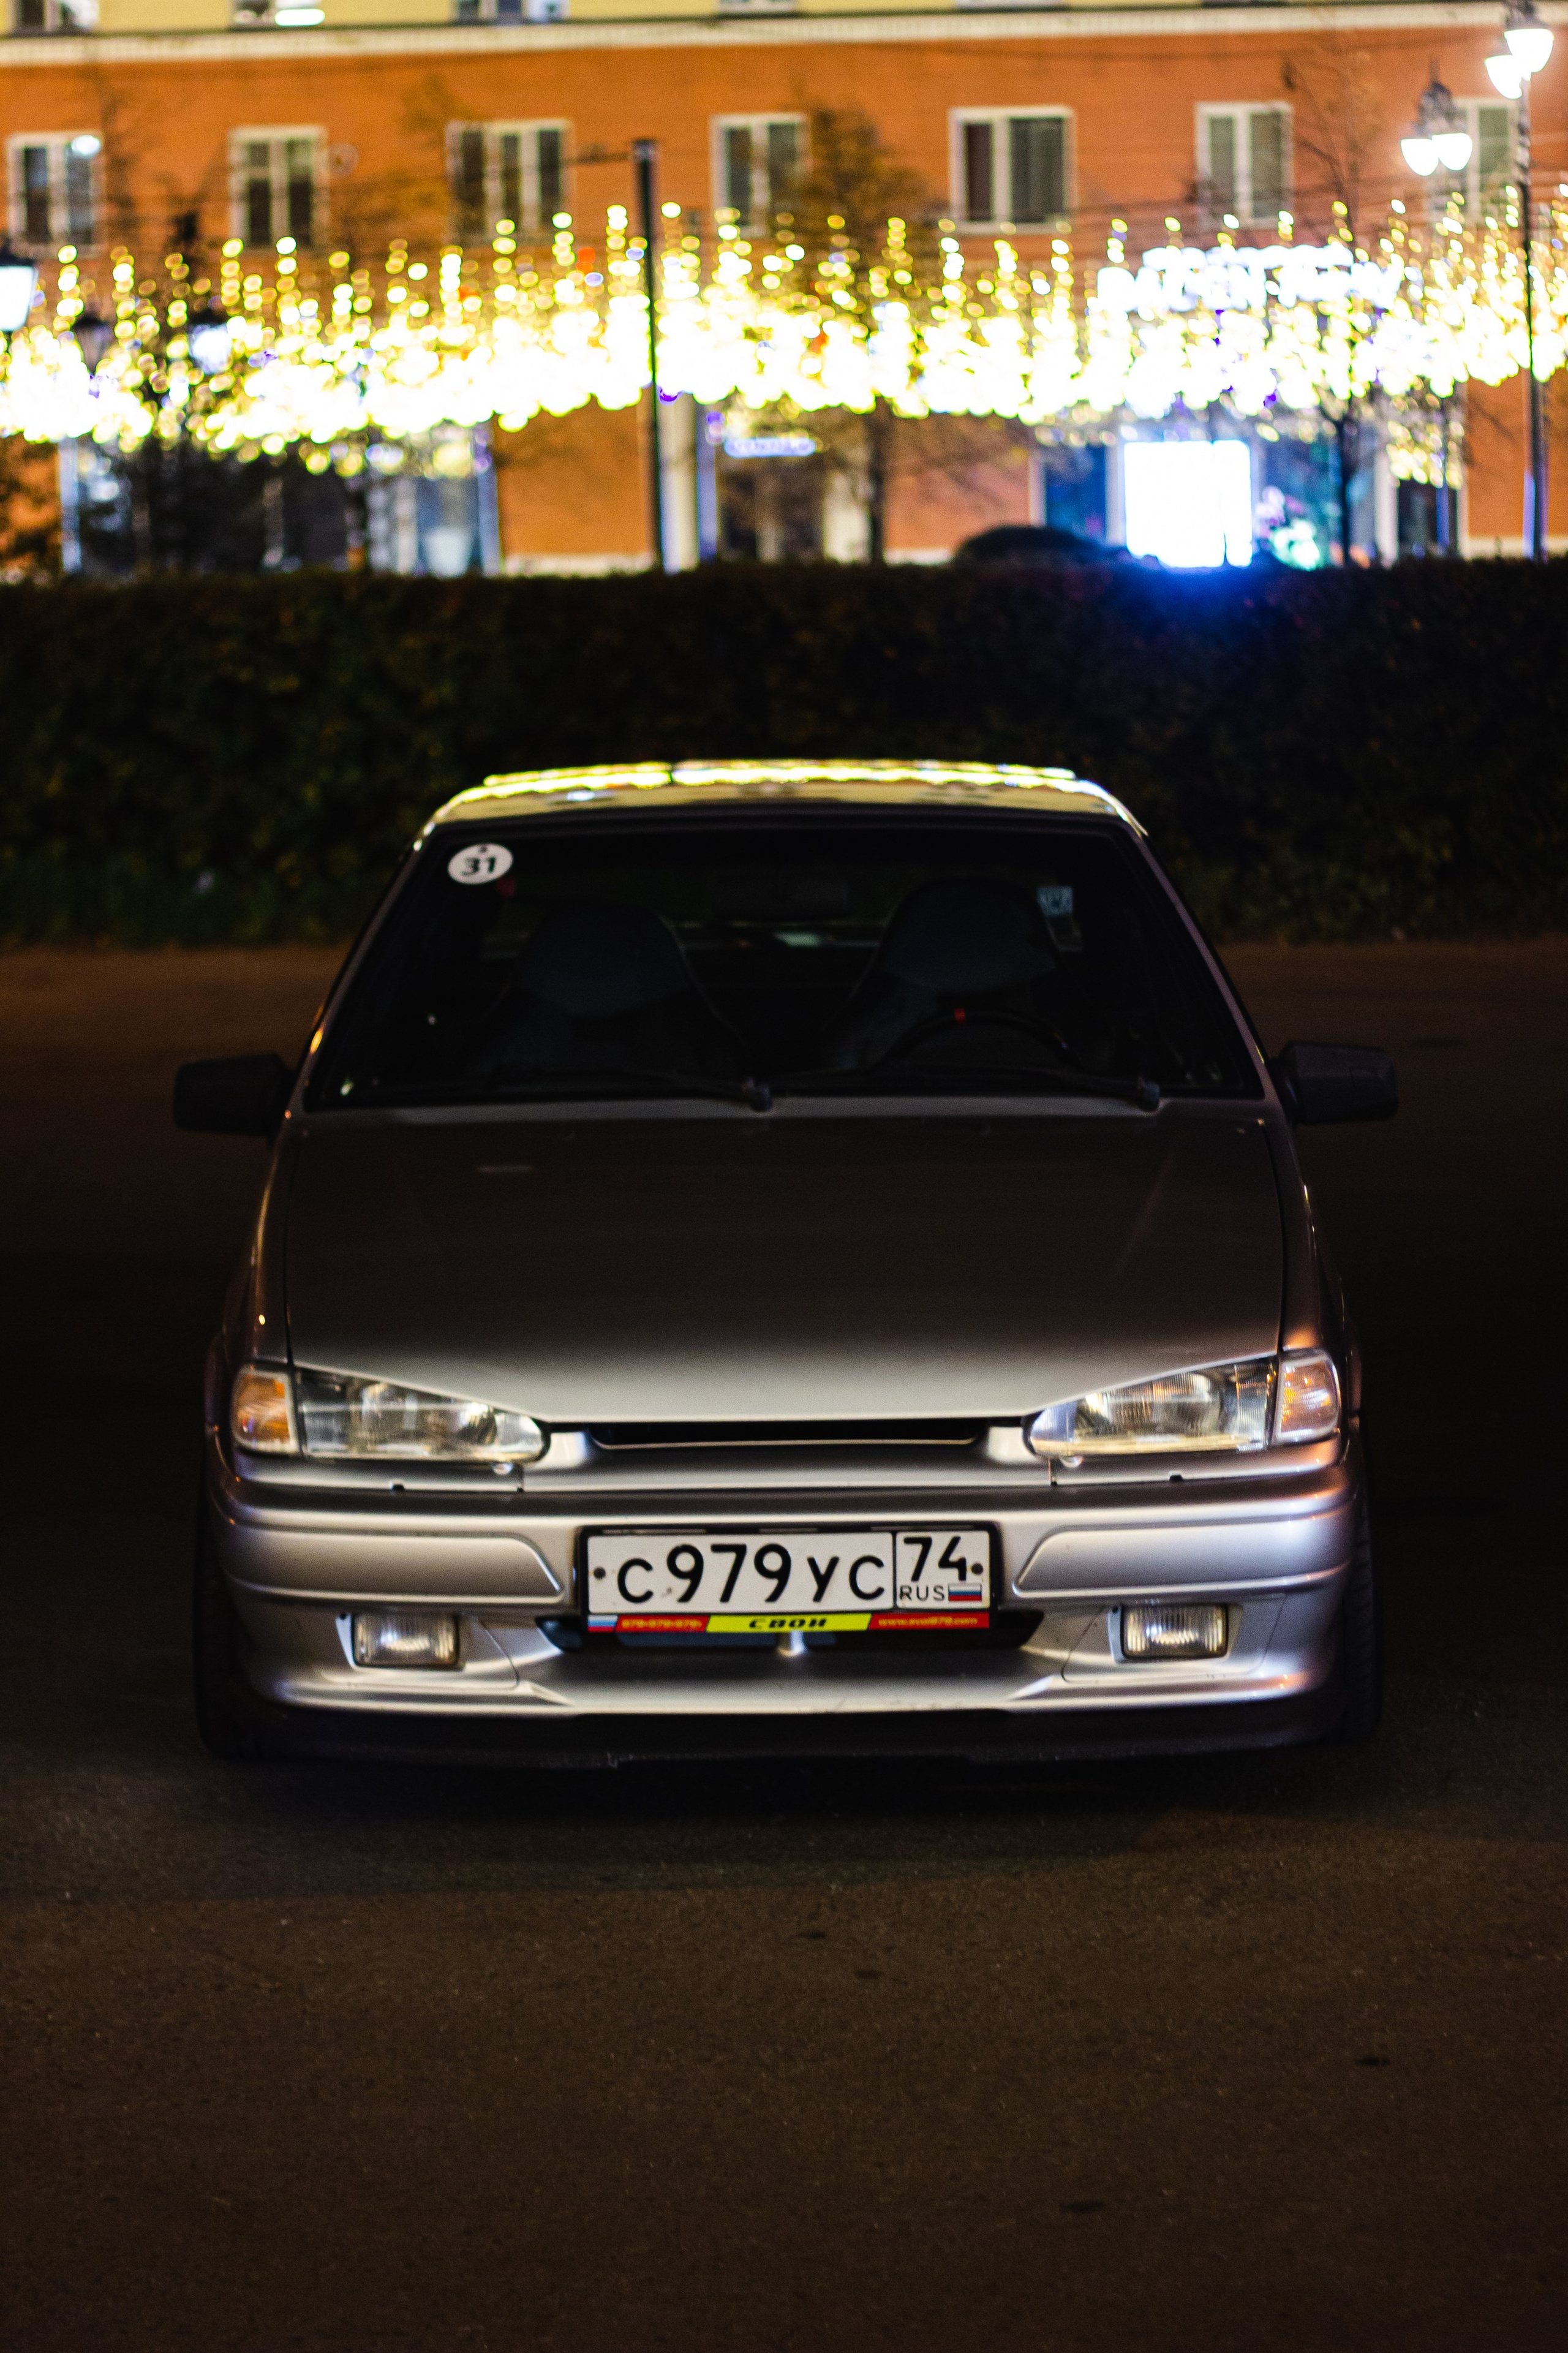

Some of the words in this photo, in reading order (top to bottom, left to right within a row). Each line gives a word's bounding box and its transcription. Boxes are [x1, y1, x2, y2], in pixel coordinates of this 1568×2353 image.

[461, 856, 497, 876] 31
[903, 1535, 968, 1582] 74
[899, 1585, 945, 1601] RUS
